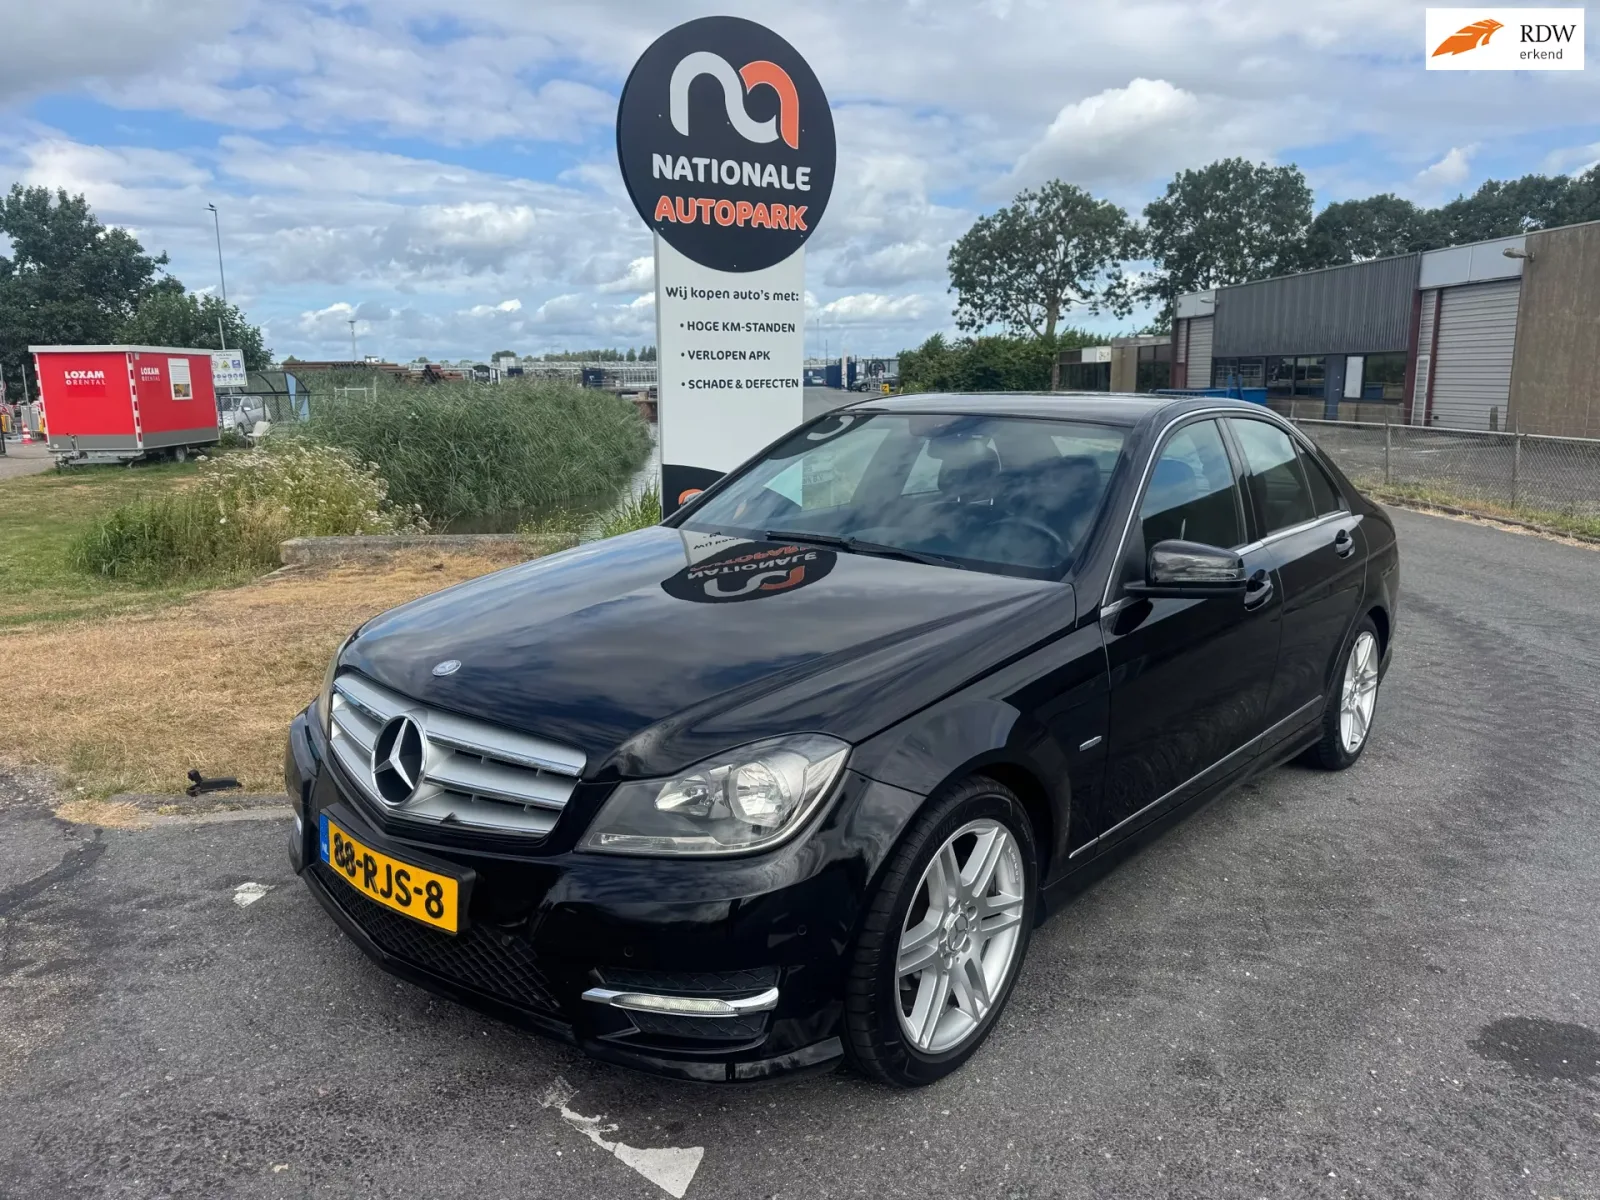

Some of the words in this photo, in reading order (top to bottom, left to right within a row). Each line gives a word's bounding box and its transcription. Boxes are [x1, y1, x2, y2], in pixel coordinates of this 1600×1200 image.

[652, 153, 812, 191] NATIONALE
[654, 195, 809, 231] AUTOPARK
[665, 286, 688, 300] Wij
[690, 287, 730, 301] kopen
[733, 289, 770, 301] auto's
[772, 291, 800, 301] met:
[687, 321, 720, 332] HOGE
[722, 321, 796, 333] KM-STANDEN
[687, 350, 747, 360] VERLOPEN
[748, 350, 771, 361] APK
[64, 370, 105, 379] LOXAM
[140, 367, 160, 376] LOXAM
[688, 379, 734, 389] SCHADE
[735, 380, 743, 389] &
[745, 379, 799, 389] DEFECTEN
[333, 832, 445, 920] 88-RJS-8
